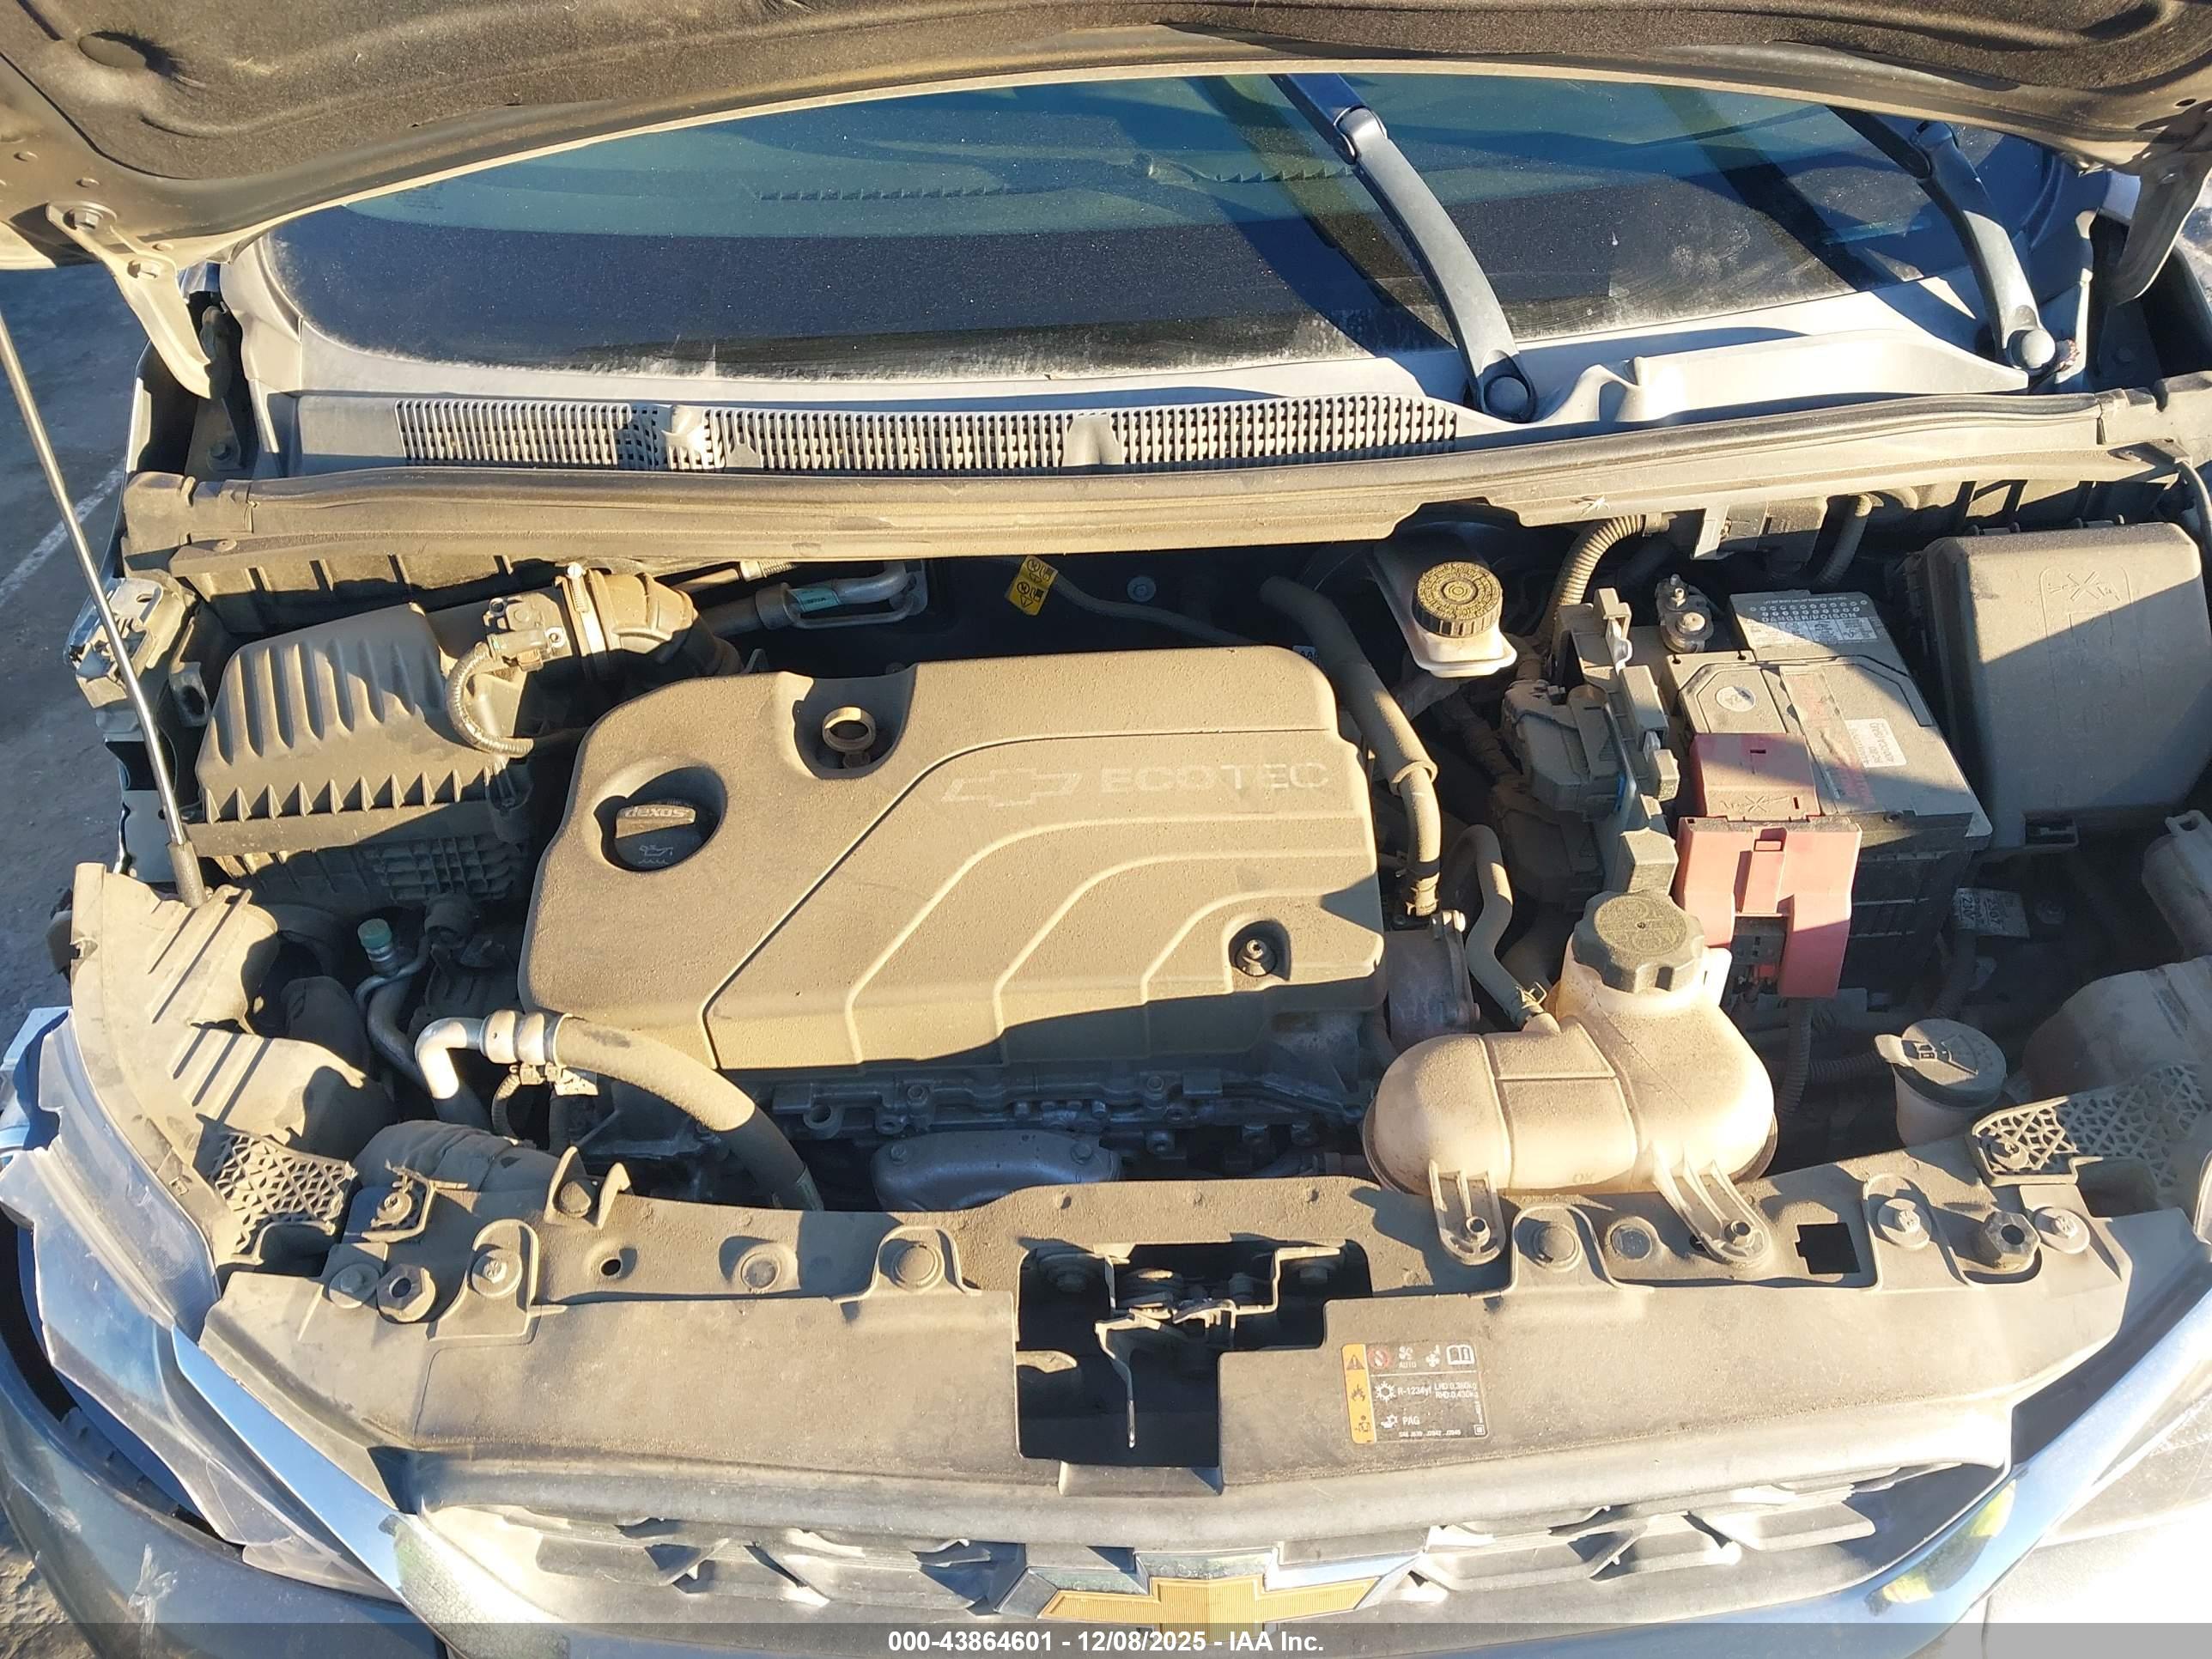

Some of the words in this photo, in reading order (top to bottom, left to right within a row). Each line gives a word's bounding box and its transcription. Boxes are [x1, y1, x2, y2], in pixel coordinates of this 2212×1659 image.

[1099, 761, 1329, 793] ECOTEC
[624, 805, 688, 818] dexos
[1399, 1360, 1417, 1369] AUTO
[1397, 1385, 1431, 1396] R-1234yf
[1402, 1416, 1420, 1425] PAG
